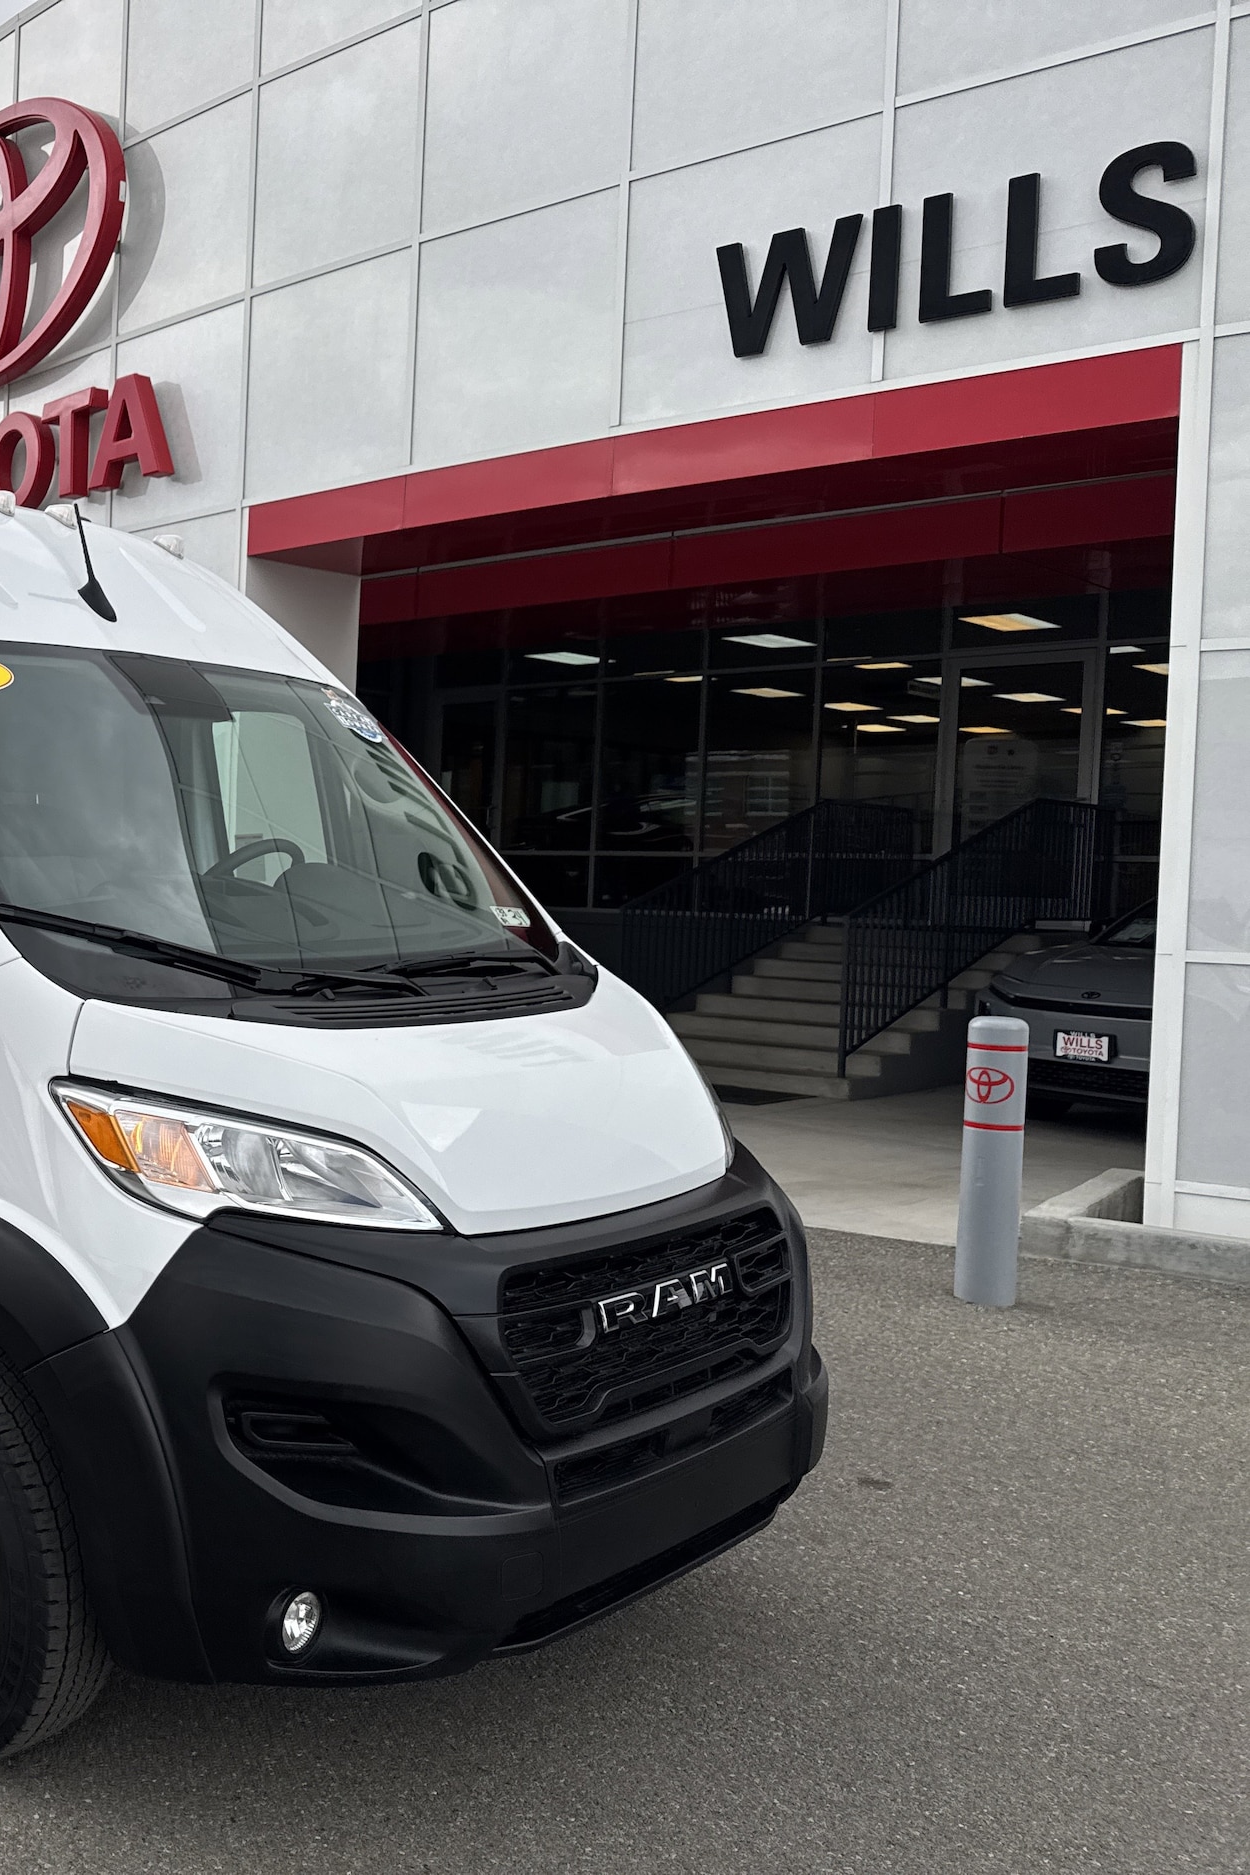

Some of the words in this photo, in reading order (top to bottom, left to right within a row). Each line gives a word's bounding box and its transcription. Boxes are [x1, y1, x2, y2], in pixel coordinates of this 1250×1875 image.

[716, 140, 1197, 358] WILLS
[1062, 1036, 1103, 1050] WILLS
[1072, 1047, 1104, 1057] TOYOTA
[597, 1263, 733, 1334] RAM
